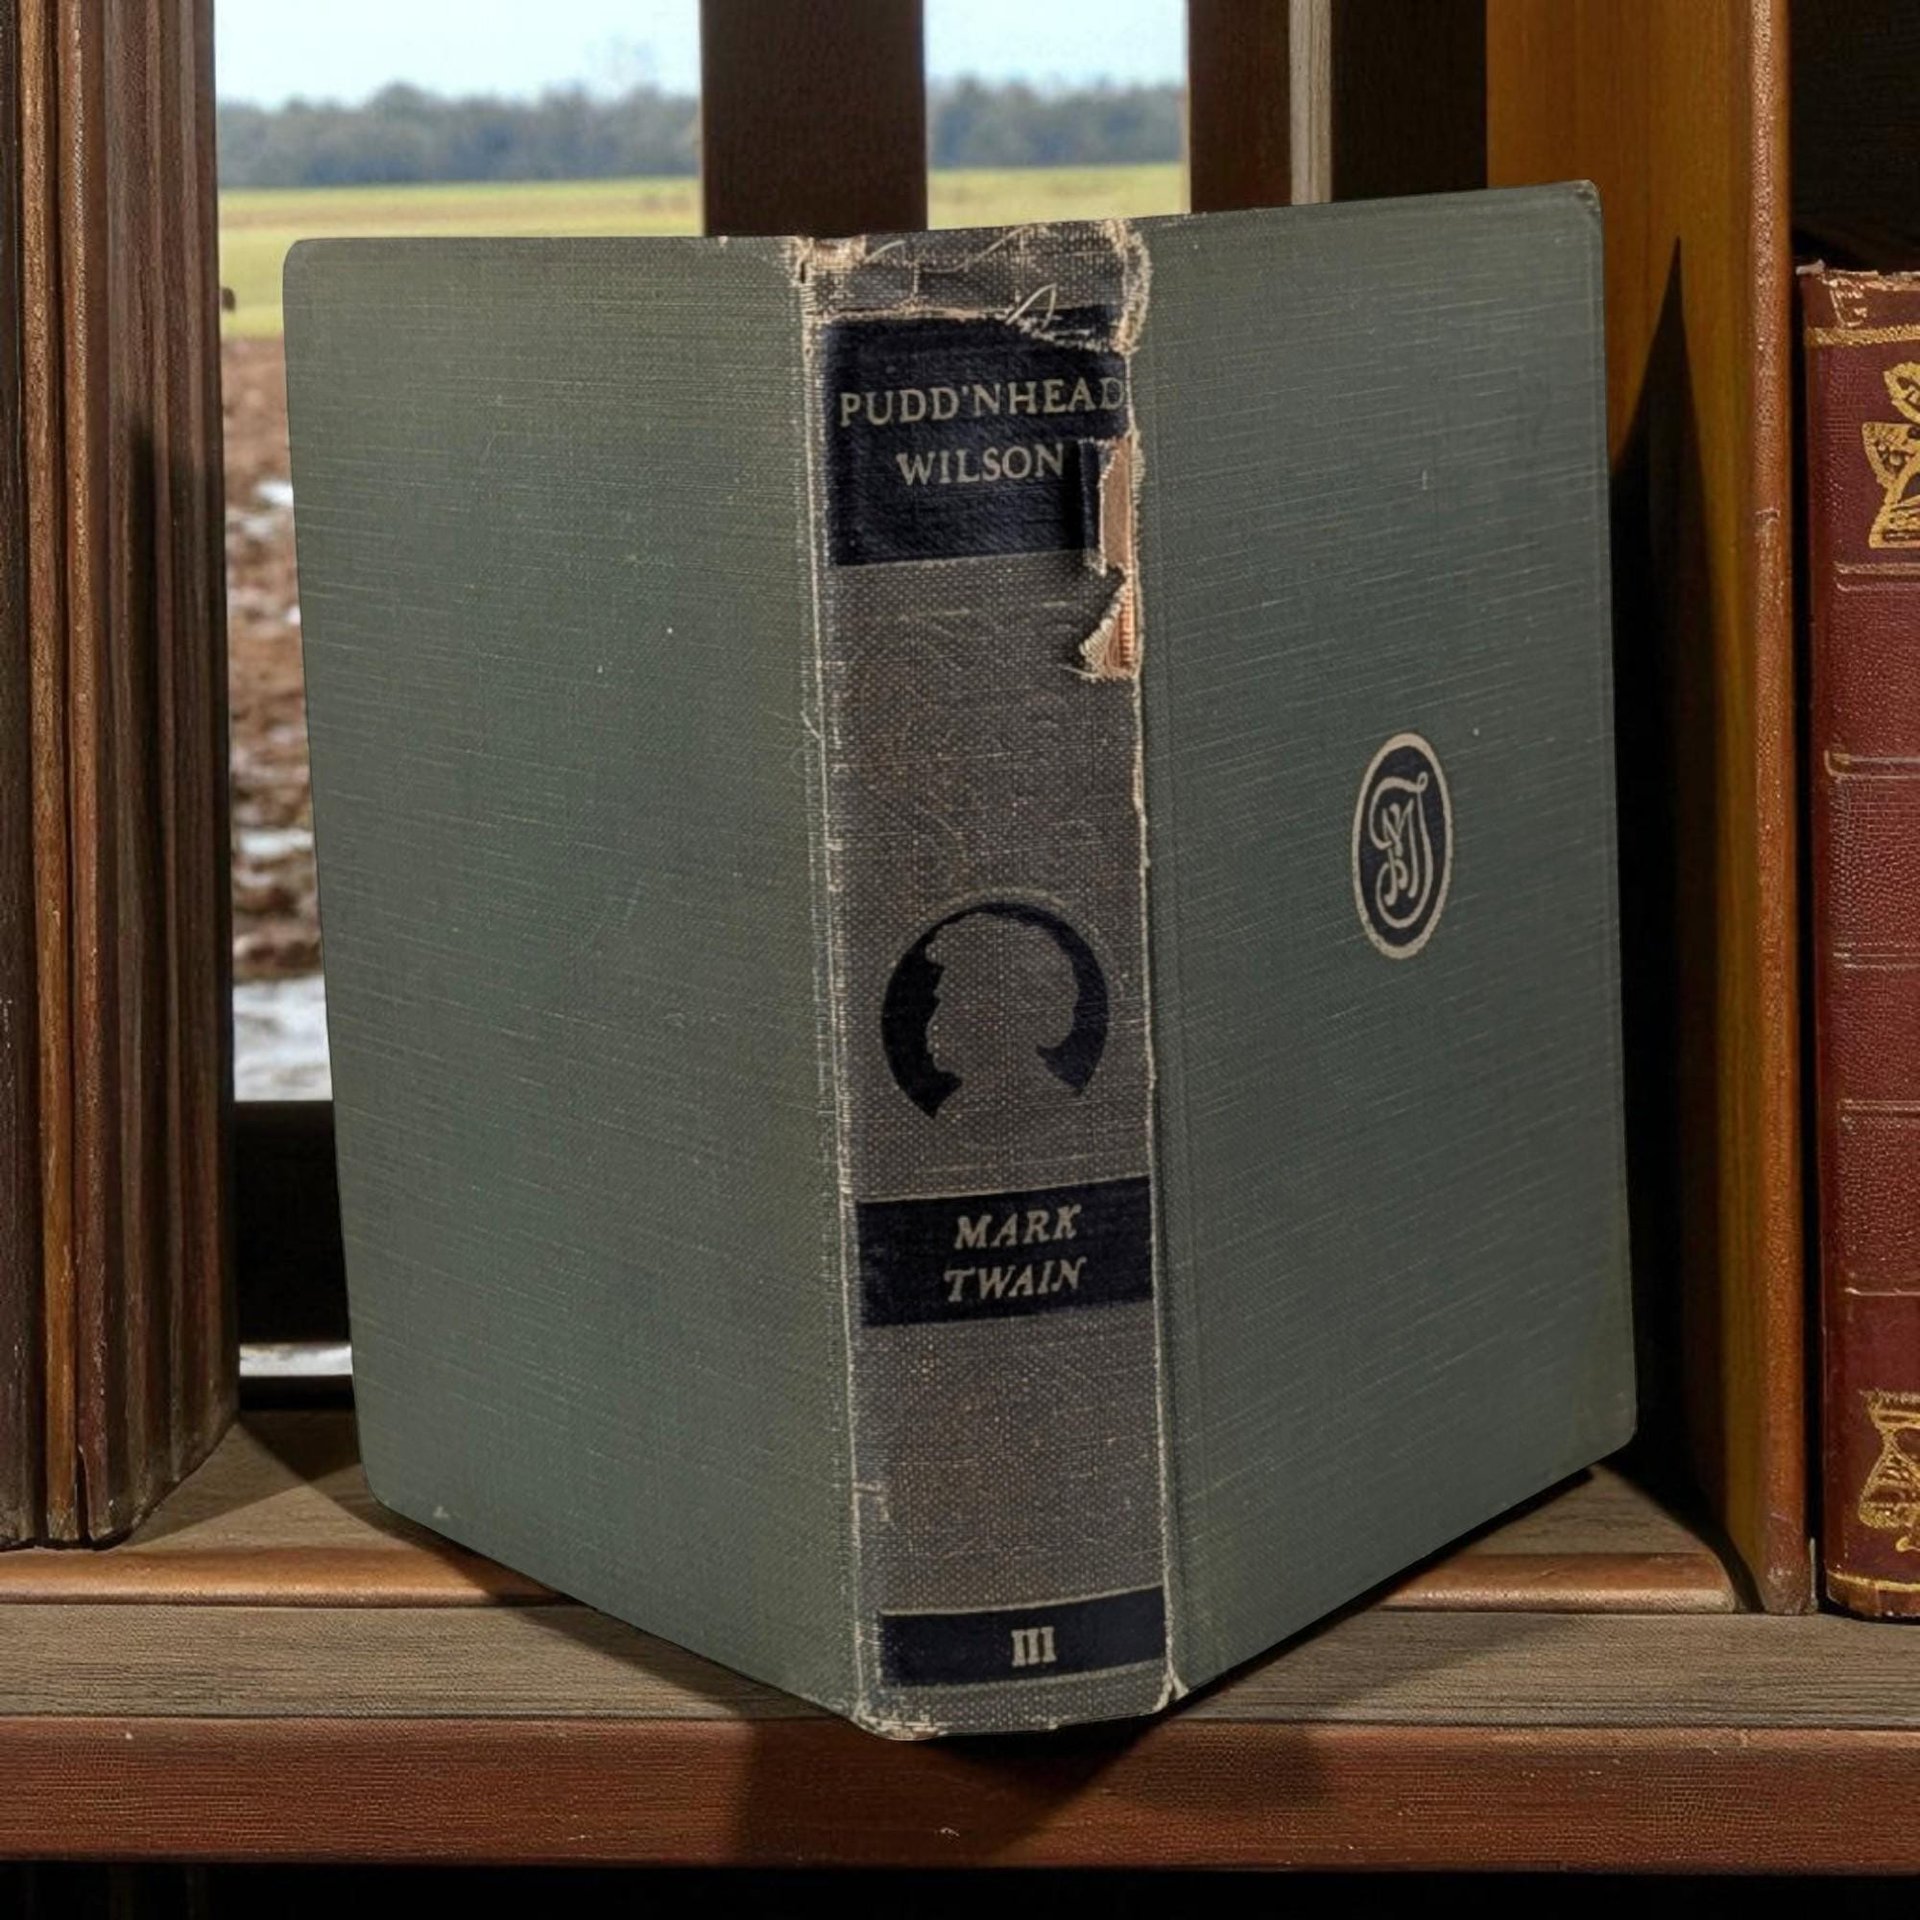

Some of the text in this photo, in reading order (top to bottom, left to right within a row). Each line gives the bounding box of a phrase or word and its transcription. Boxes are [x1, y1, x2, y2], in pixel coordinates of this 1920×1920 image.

[840, 376, 1125, 427] PUDD'NHEAD
[896, 442, 1065, 486] WILSON
[954, 1204, 1082, 1250] MARK
[943, 1256, 1087, 1302] TWAIN
[1010, 1626, 1056, 1667] III
